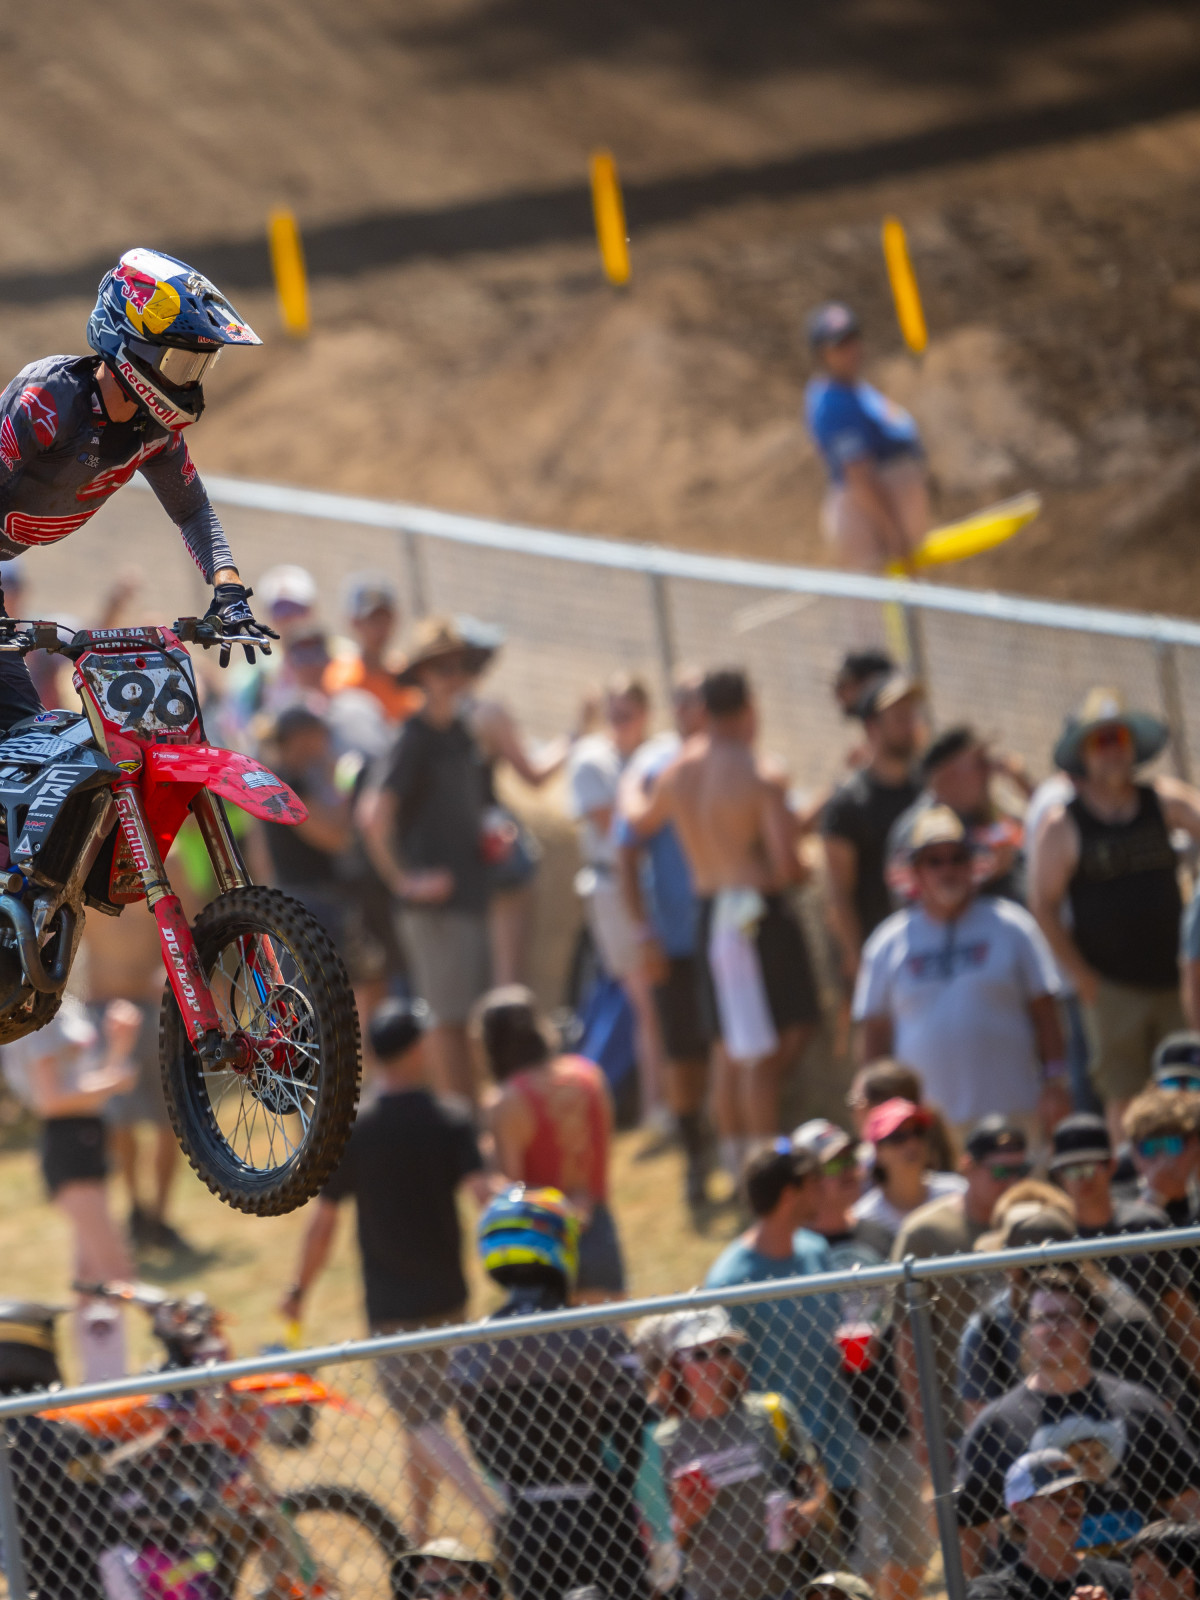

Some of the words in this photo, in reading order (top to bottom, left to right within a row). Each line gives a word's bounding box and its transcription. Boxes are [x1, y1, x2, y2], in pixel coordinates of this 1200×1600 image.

[91, 627, 153, 639] RENTHAL
[106, 672, 196, 729] 96
[115, 798, 150, 874] SHOWA
[162, 927, 200, 1012] DUNLOP
